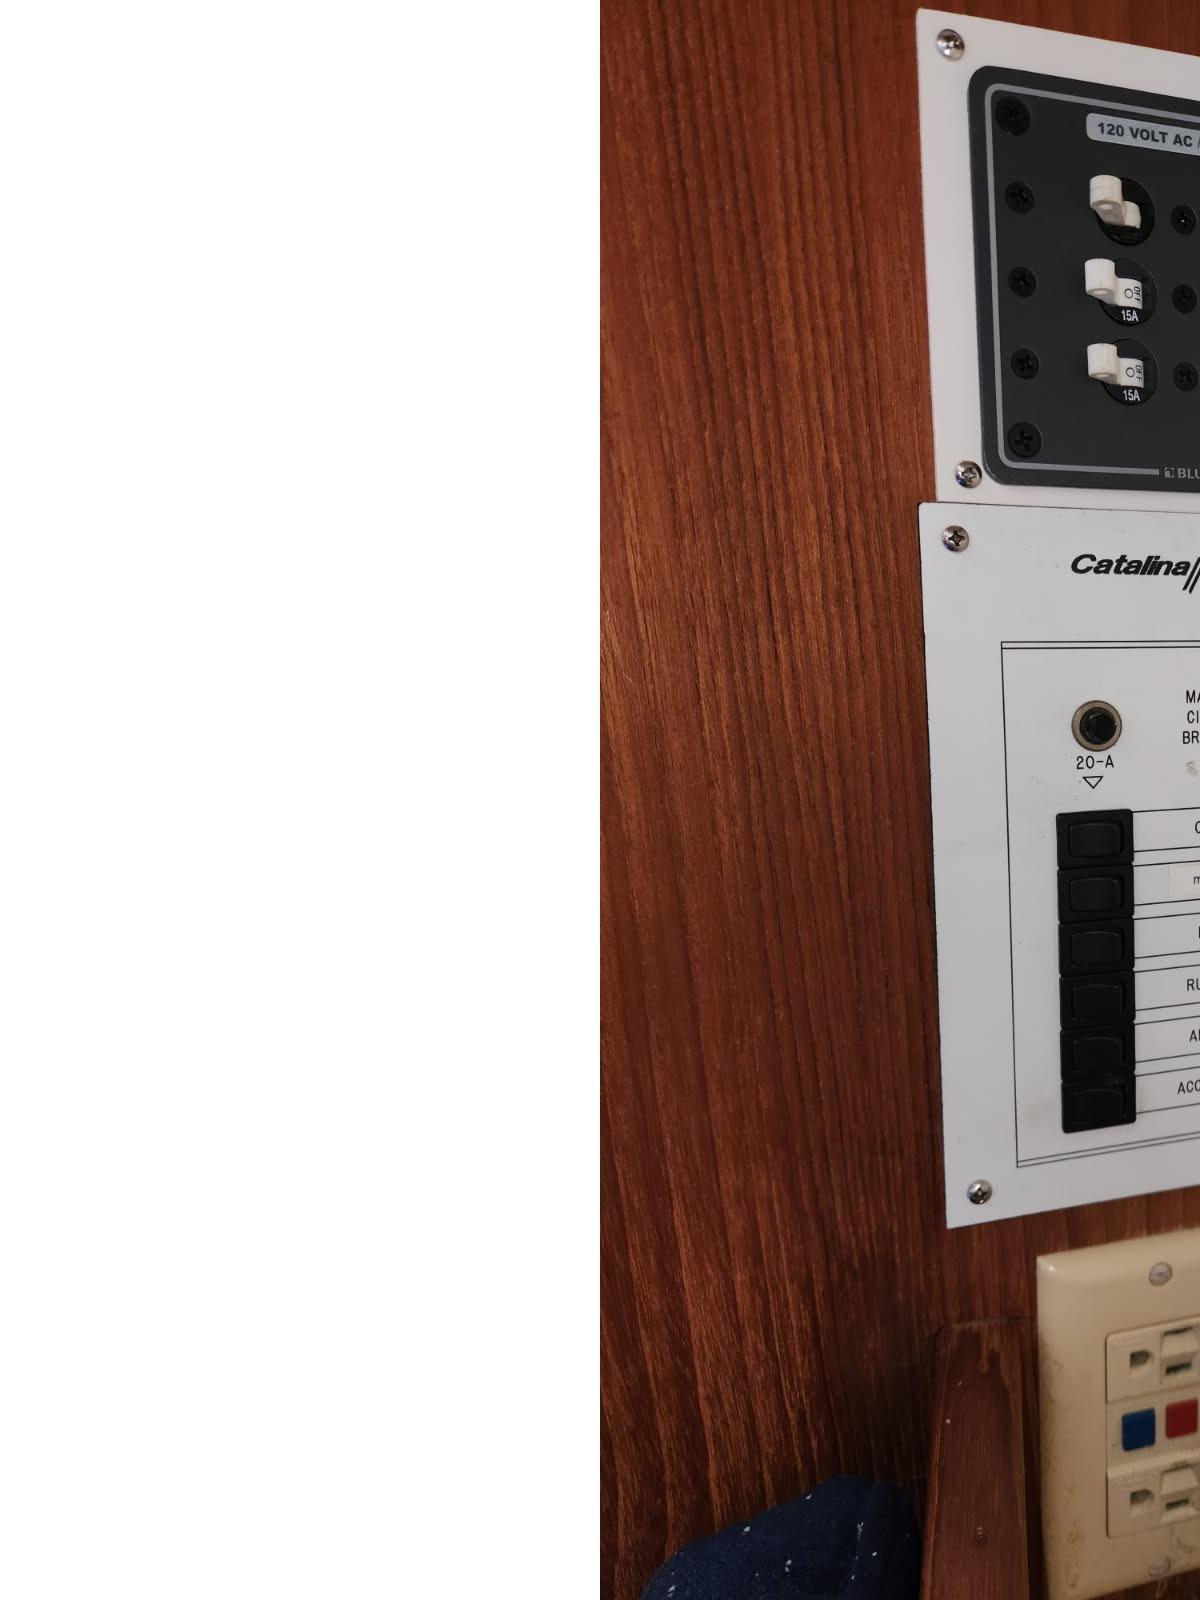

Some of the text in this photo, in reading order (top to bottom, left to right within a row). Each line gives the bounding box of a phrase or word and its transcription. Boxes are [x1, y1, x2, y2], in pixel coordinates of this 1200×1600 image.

[1097, 121, 1125, 138] 120
[1128, 126, 1169, 144] VOLT
[1172, 133, 1193, 148] AC
[1121, 309, 1140, 322] 15A
[1123, 389, 1141, 402] 15A
[1070, 553, 1191, 576] Catalina
[1076, 754, 1114, 770] 20-A
